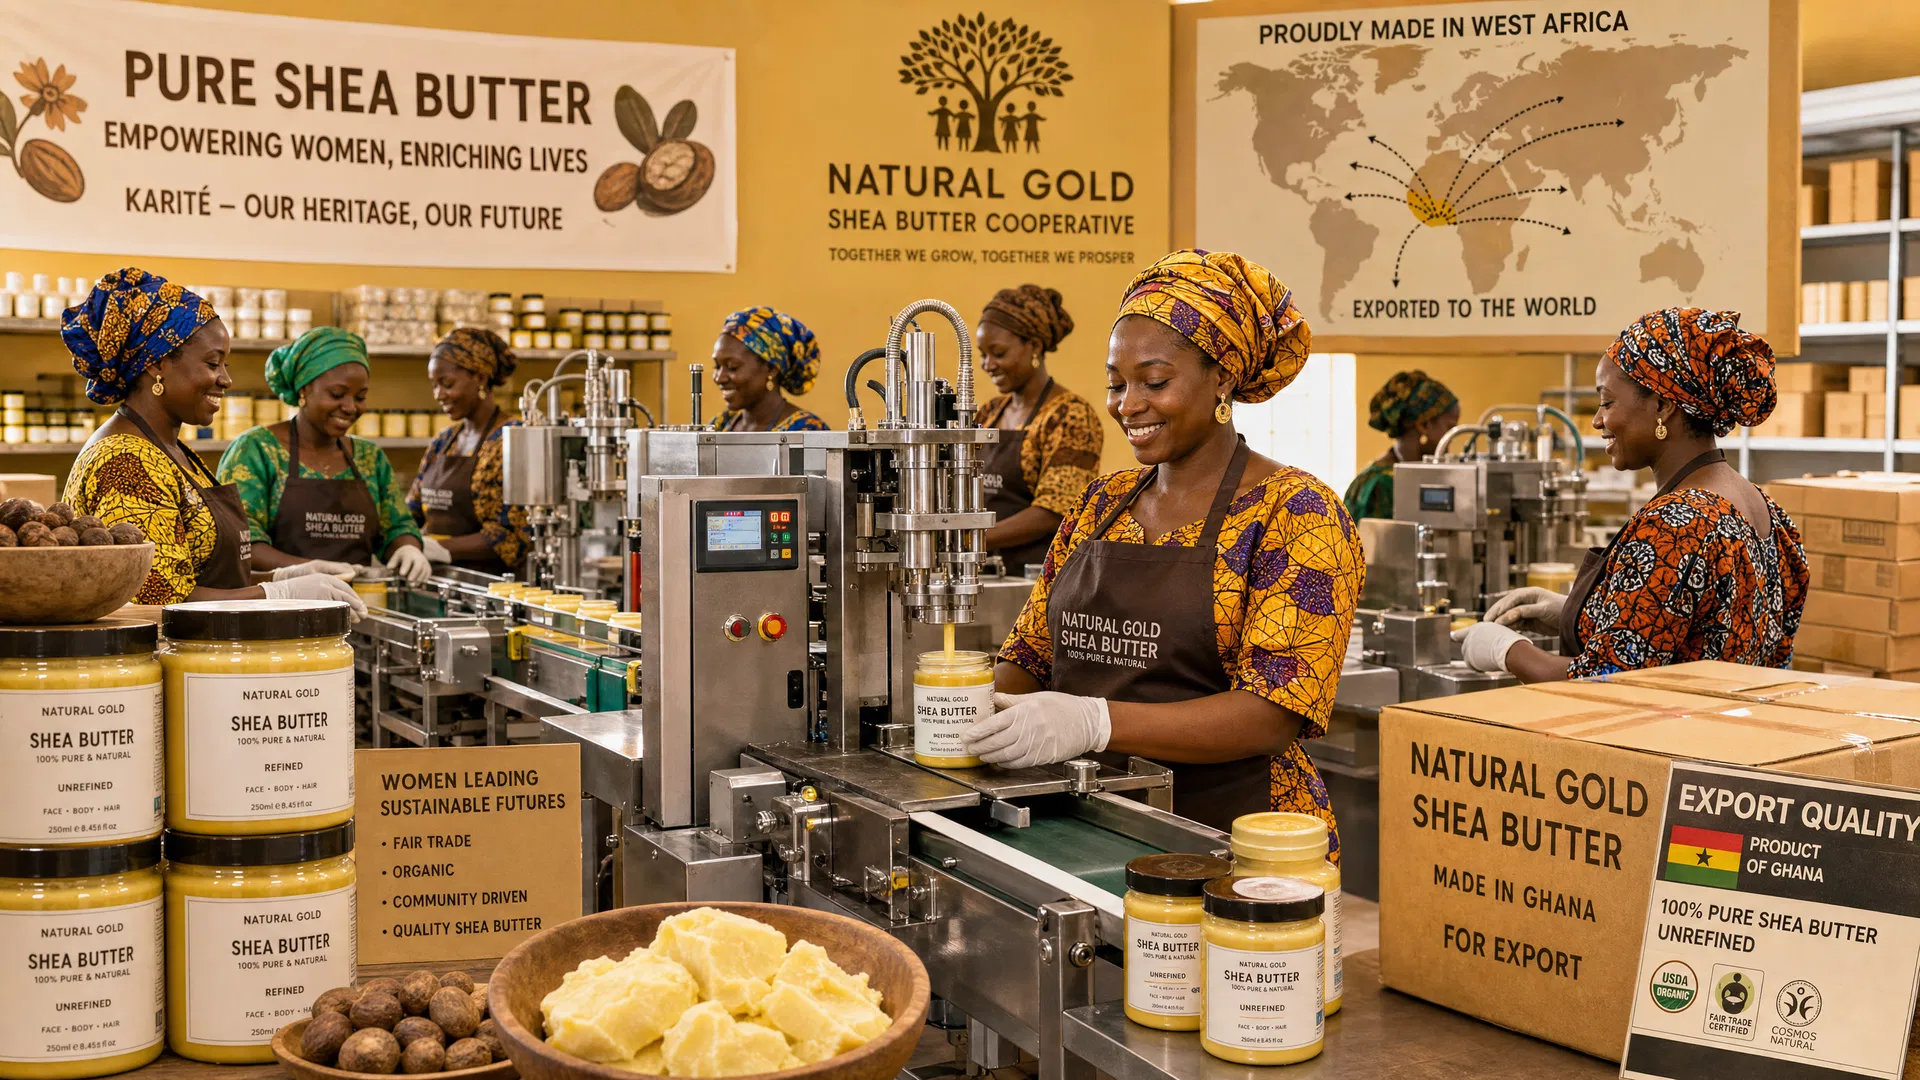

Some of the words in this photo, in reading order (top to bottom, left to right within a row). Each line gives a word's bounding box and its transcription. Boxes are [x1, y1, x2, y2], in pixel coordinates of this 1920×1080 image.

[1259, 21, 1363, 45] PROUDLY
[1371, 18, 1435, 41] MADE
[1442, 17, 1464, 38] IN
[1471, 14, 1536, 37] WEST
[1543, 10, 1629, 35] AFRICA
[124, 50, 257, 106] PURE
[275, 62, 399, 116] SHEA
[415, 72, 592, 125] BUTTER
[104, 121, 283, 158] EMPOWERING
[291, 133, 395, 170] WOMEN,
[402, 141, 522, 171] ENRICHING
[530, 148, 588, 174] LIVES
[829, 163, 1005, 199] NATURAL
[1023, 169, 1134, 202] GOLD
[126, 186, 211, 216] KARITÉ
[244, 194, 295, 220] OUR
[303, 198, 418, 230] HERITAGE,
[425, 202, 472, 228] OUR
[481, 206, 563, 230] FUTURE
[829, 209, 887, 231] SHEA
[897, 211, 977, 233] BUTTER
[986, 213, 1134, 235] COOPERATIVE
[829, 248, 901, 263] TOGETHER
[906, 249, 927, 263] WE
[931, 249, 977, 265] GROW,
[983, 250, 1050, 263] TOGETHER
[1054, 251, 1075, 263] WE
[1080, 252, 1135, 264] PROSPER
[1353, 299, 1440, 319] EXPORTED
[1448, 299, 1473, 318] TO
[1480, 298, 1516, 317] THE
[1524, 297, 1597, 317] WORLD
[306, 512, 343, 523] NATURAL
[345, 514, 366, 523] GOLD
[306, 522, 329, 532] SHEA
[332, 523, 365, 534] BUTTER
[1062, 611, 1119, 635] NATURAL
[1123, 620, 1161, 638] GOLD
[1061, 630, 1097, 651] SHEA
[1101, 636, 1158, 659] BUTTER
[1067, 650, 1085, 661] 100%
[1087, 653, 1105, 663] PURE
[1106, 656, 1112, 664] &
[1114, 657, 1147, 669] NATURAL
[243, 690, 292, 700] NATURAL
[296, 688, 320, 698] GOLD
[42, 706, 94, 717] NATURAL
[98, 704, 125, 715] GOLD
[918, 706, 938, 716] SHEA
[941, 707, 977, 717] BUTTER
[232, 716, 273, 732] SHEA
[278, 712, 328, 730] BUTTER
[30, 733, 73, 749] SHEA
[79, 729, 134, 747] BUTTER
[238, 737, 260, 746] 100%
[263, 737, 283, 745] PURE
[294, 734, 326, 743] NATURAL
[36, 755, 59, 763] 100%
[62, 754, 85, 762] PURE
[87, 754, 93, 762] &
[96, 751, 131, 761] NATURAL
[265, 762, 304, 772] REFINED
[58, 782, 113, 793] UNREFINED
[382, 772, 457, 791] WOMEN
[464, 770, 539, 788] LEADING
[1411, 742, 1545, 800] NATURAL
[1556, 769, 1648, 818] GOLD
[246, 786, 264, 794] FACE
[274, 785, 294, 793] BODY
[251, 803, 274, 811] 250ml
[381, 797, 491, 816] SUSTAINABLE
[496, 794, 566, 812] FUTURES
[1678, 784, 1795, 825] EXPORT
[1802, 802, 1920, 842] QUALITY
[1413, 794, 1489, 842] SHEA
[1502, 811, 1622, 871] BUTTER
[393, 836, 423, 850] FAIR
[427, 835, 472, 848] TRADE
[1750, 837, 1822, 860] PRODUCT
[393, 863, 455, 878] ORGANIC
[1746, 859, 1767, 874] OF
[1770, 862, 1824, 883] GHANA
[393, 893, 478, 909] COMMUNITY
[482, 890, 528, 905] DRIVEN
[1434, 864, 1486, 897] MADE
[1495, 879, 1514, 904] IN
[1523, 886, 1596, 923] GHANA
[244, 914, 293, 925] NATURAL
[297, 910, 322, 922] GOLD
[1662, 898, 1703, 919] 100%
[1708, 904, 1753, 926] PURE
[1758, 912, 1803, 934] SHEA
[1808, 919, 1878, 945] BUTTER
[41, 927, 92, 938] NATURAL
[97, 923, 124, 935] GOLD
[393, 922, 451, 938] QUALITY
[455, 920, 489, 934] SHEA
[494, 917, 542, 932] BUTTER
[232, 940, 273, 956] SHEA
[279, 933, 330, 954] BUTTER
[1137, 939, 1159, 951] SHEA
[1163, 943, 1199, 952] BUTTER
[1658, 924, 1755, 953] UNREFINED
[28, 954, 72, 970] SHEA
[78, 947, 134, 968] BUTTER
[1444, 924, 1485, 958] FOR
[1494, 937, 1583, 981] EXPORT
[238, 962, 260, 970] 100%
[263, 960, 284, 969] PURE
[295, 955, 328, 966] NATURAL
[35, 976, 57, 984] 100%
[61, 975, 83, 983] PURE
[95, 969, 131, 980] NATURAL
[1150, 972, 1186, 980] UNREFINED
[1225, 970, 1252, 983] SHEA
[1257, 972, 1300, 984] BUTTER
[1662, 972, 1688, 987] USDA
[266, 986, 305, 997] REFINED
[1657, 987, 1689, 1000] ORGANIC
[56, 999, 112, 1012] UNREFINED
[275, 1009, 294, 1017] BODY
[1240, 1004, 1285, 1012] UNREFINED
[42, 1026, 61, 1034] FACE
[72, 1024, 94, 1033] BODY
[103, 1021, 120, 1029] HAIR
[1710, 1014, 1726, 1023] FAIR
[1729, 1017, 1752, 1027] TRADE
[1709, 1022, 1749, 1036] CERTIFIED
[1772, 1026, 1817, 1041] COSMOS
[47, 1044, 71, 1052] 250ml
[1771, 1036, 1815, 1051] NATURAL
